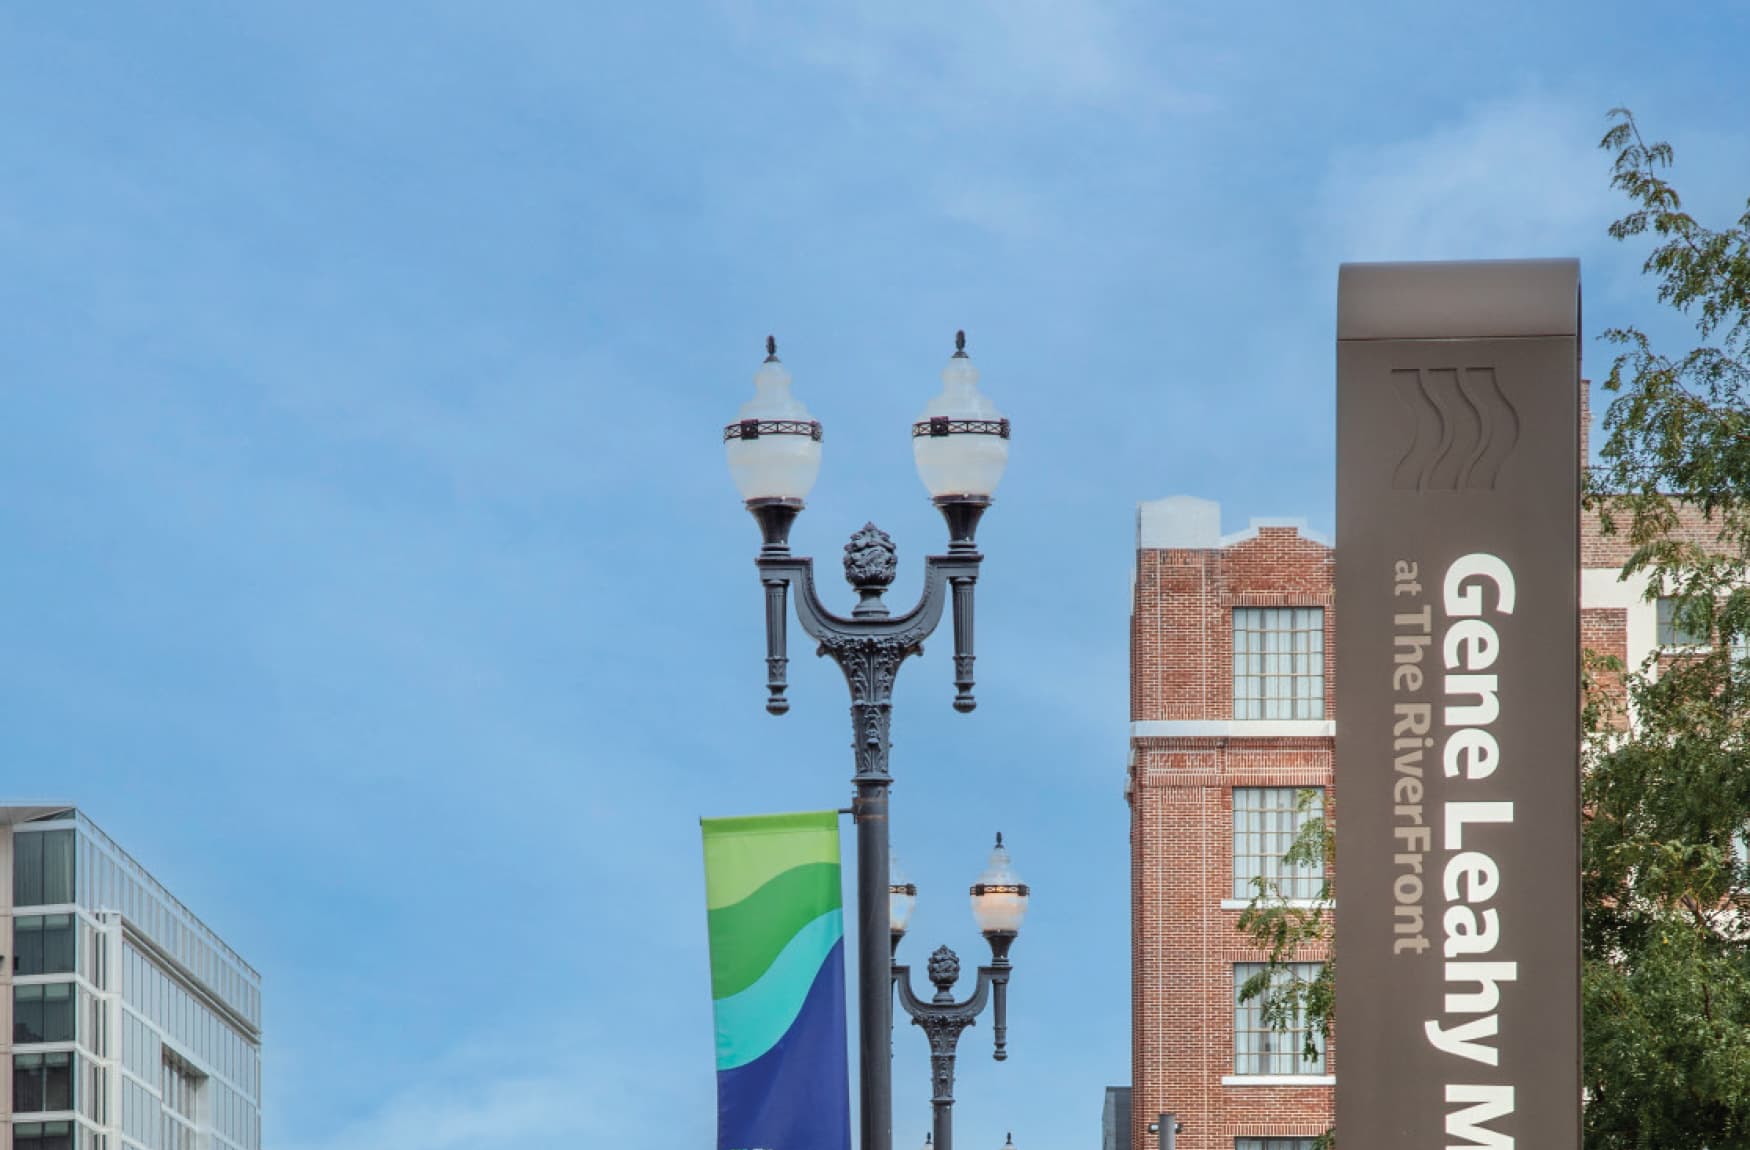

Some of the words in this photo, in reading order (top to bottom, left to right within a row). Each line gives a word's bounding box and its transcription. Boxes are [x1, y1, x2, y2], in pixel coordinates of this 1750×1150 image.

[1393, 604, 1432, 692] The
[1394, 560, 1423, 597] at
[1443, 553, 1516, 780] Gene
[1393, 702, 1434, 955] RiverFront
[1424, 801, 1518, 1067] Leahy
